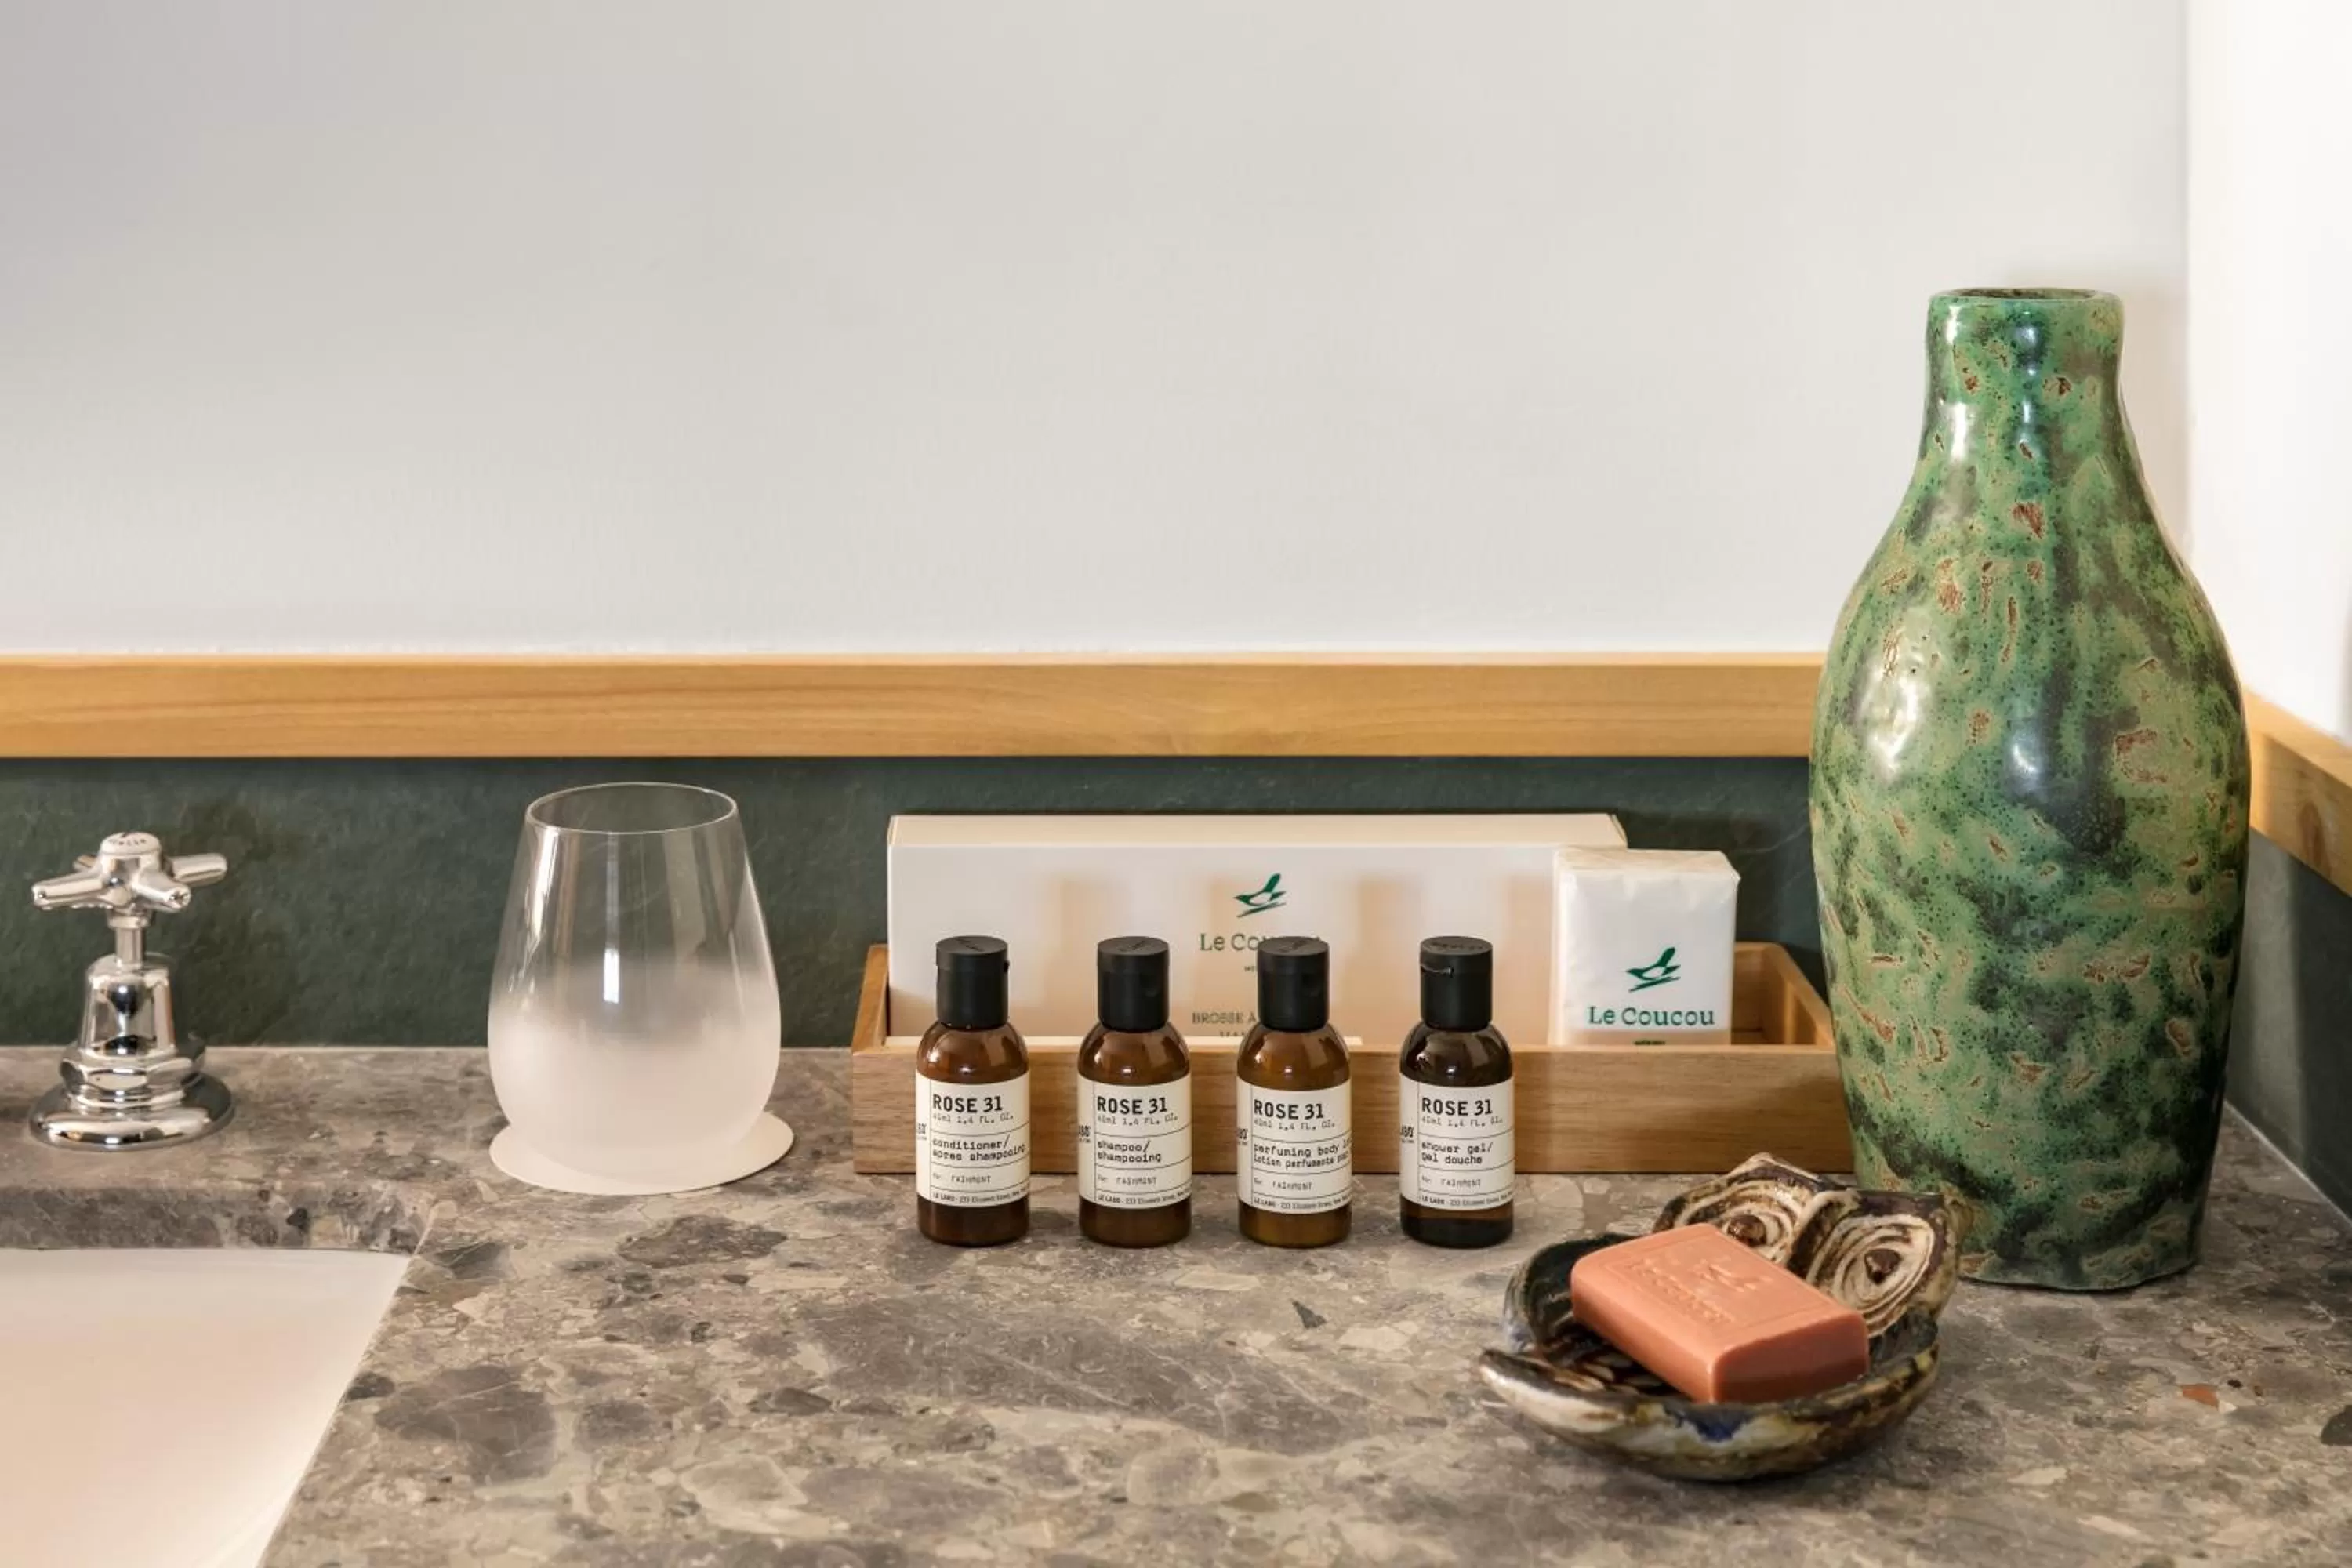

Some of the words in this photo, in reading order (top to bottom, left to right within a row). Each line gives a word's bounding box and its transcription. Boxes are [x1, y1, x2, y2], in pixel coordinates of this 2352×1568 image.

[1200, 934, 1225, 951] Le
[1192, 1012, 1244, 1024] BROSSE
[1588, 1006, 1616, 1025] Le
[1621, 1007, 1715, 1026] Coucou
[933, 1094, 978, 1113] ROSE
[983, 1095, 1003, 1112] 31
[1098, 1096, 1142, 1115] ROSE
[1148, 1097, 1167, 1114] 31
[1254, 1099, 1298, 1120] ROSE
[1305, 1103, 1323, 1120] 31
[1421, 1097, 1468, 1116] ROSE
[1474, 1098, 1493, 1115] 31
[933, 1134, 1010, 1151] conditioner/
[1098, 1140, 1151, 1152] shampoo/
[1254, 1143, 1312, 1157] perfuming
[1318, 1144, 1339, 1156] body
[1421, 1141, 1461, 1152] shower
[1467, 1141, 1494, 1154] gel/
[1098, 1152, 1161, 1163] shampooing
[1421, 1152, 1438, 1163] gel
[1445, 1155, 1483, 1164] douche
